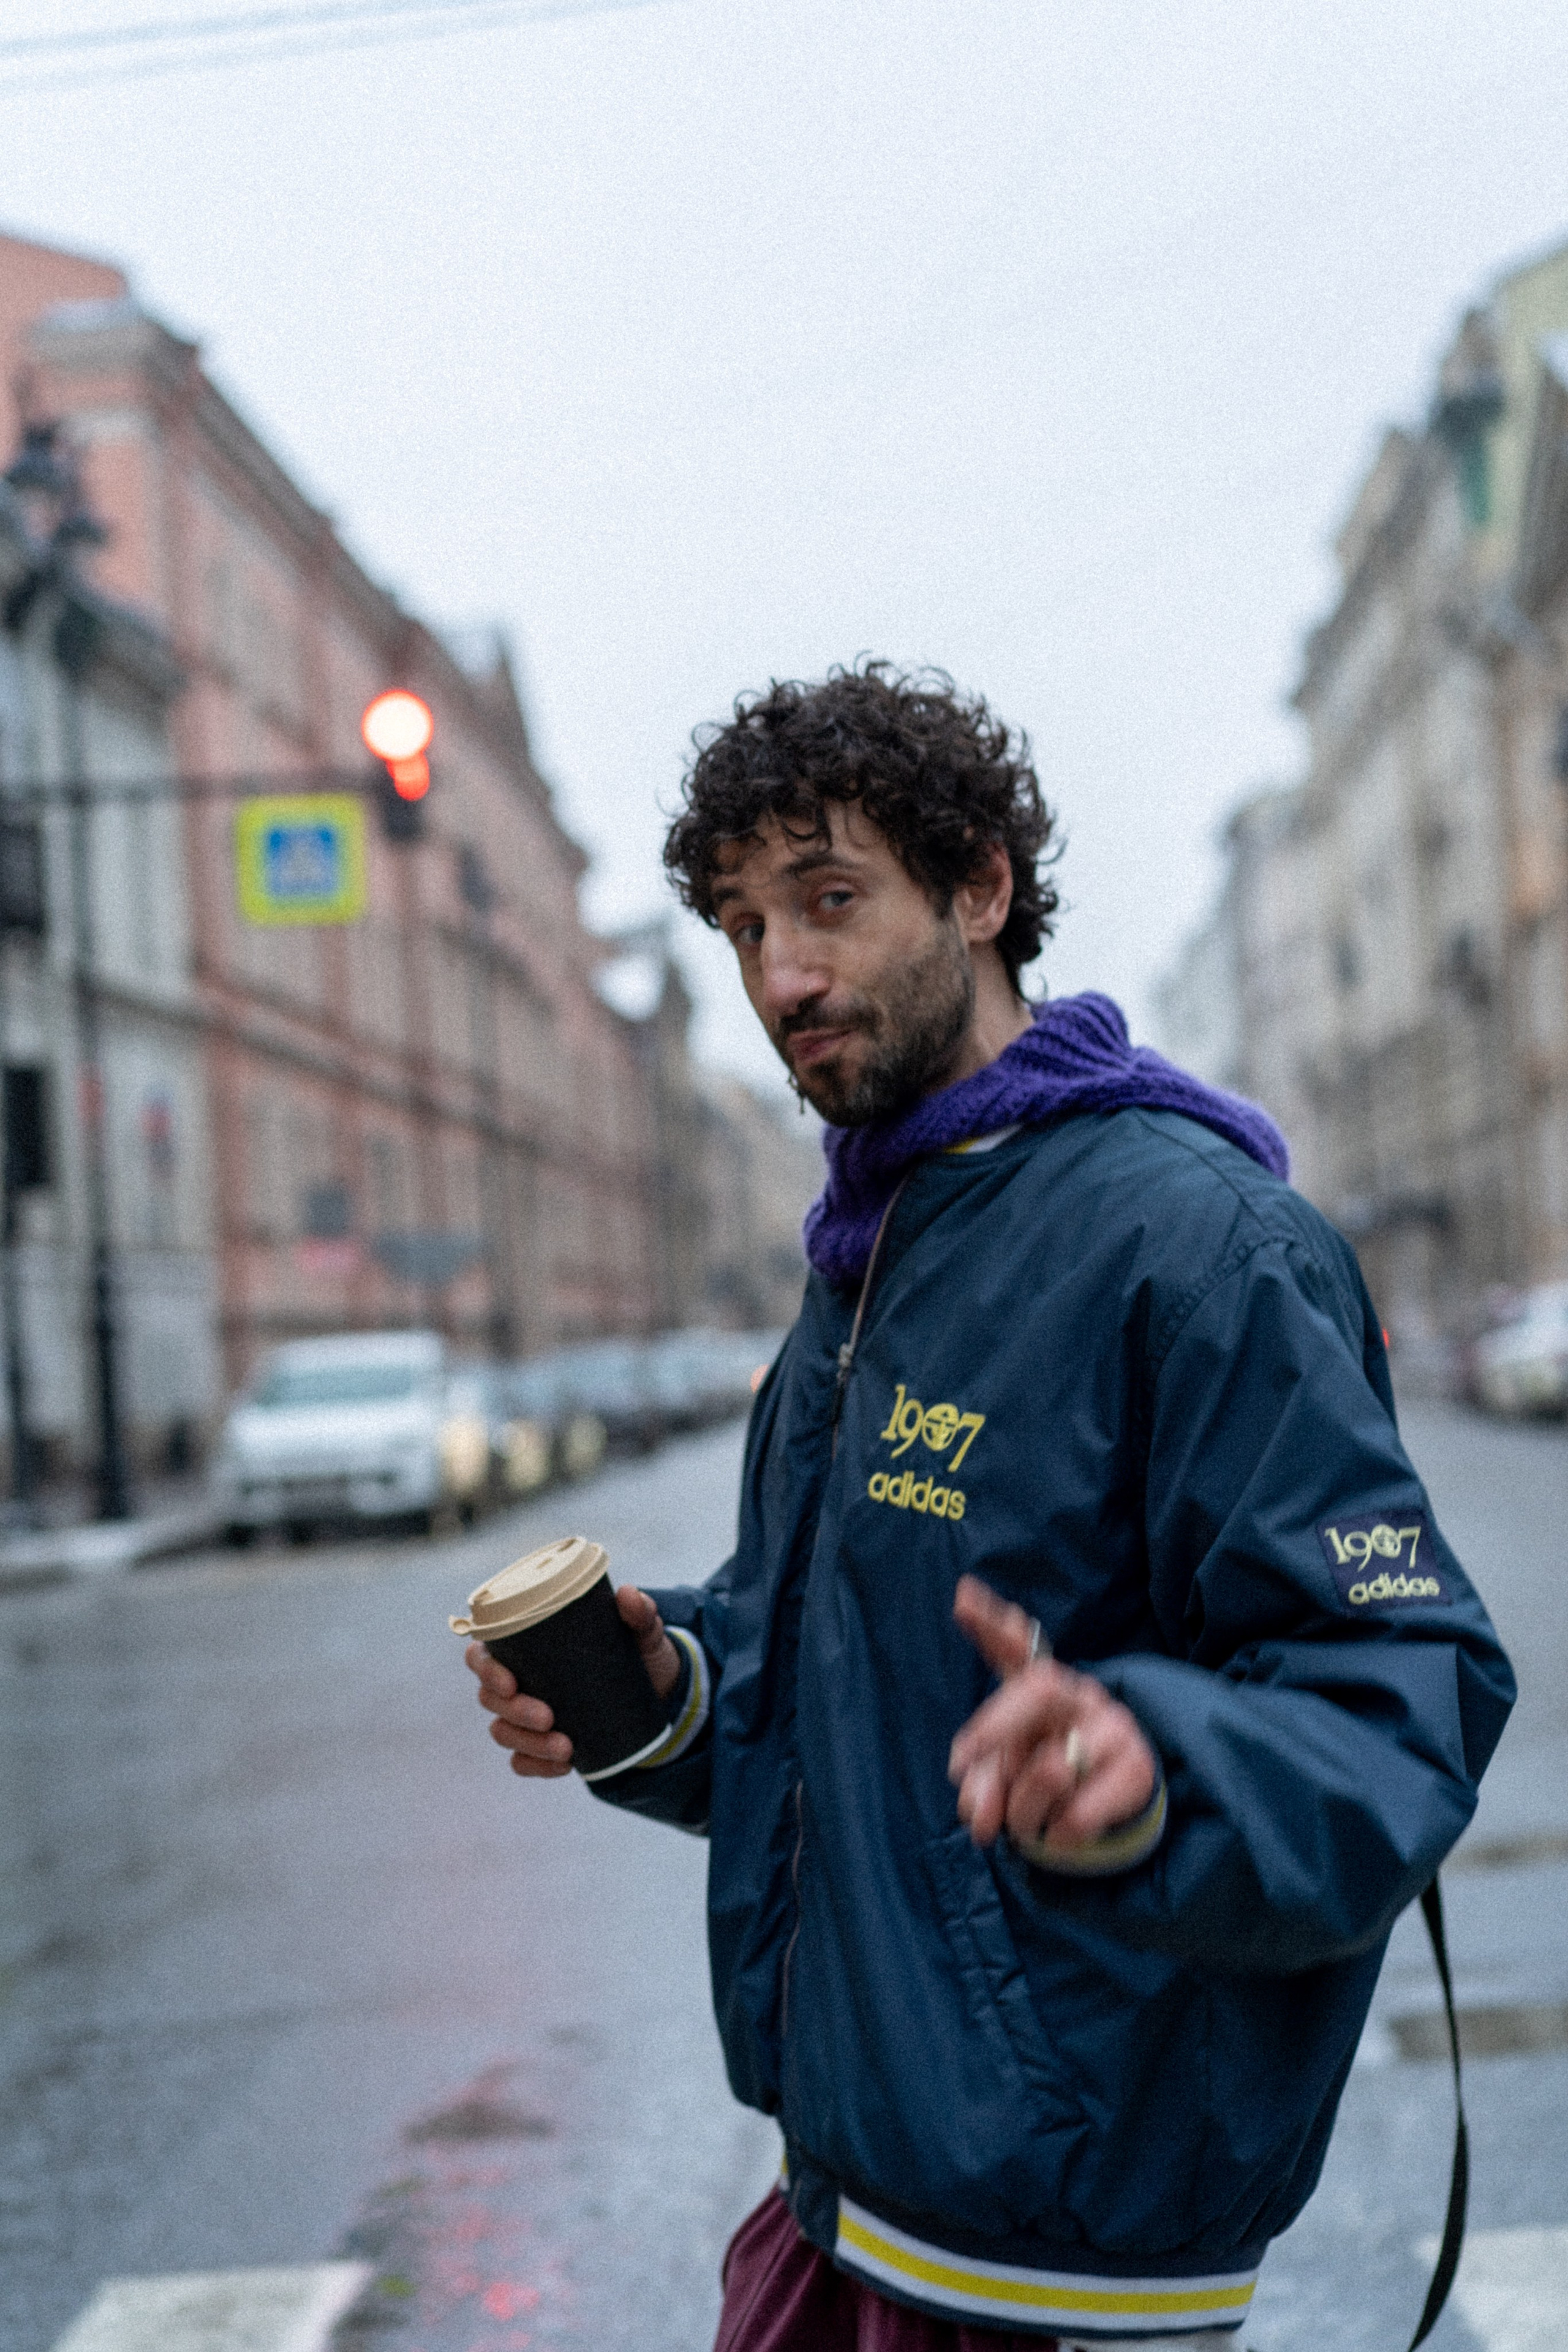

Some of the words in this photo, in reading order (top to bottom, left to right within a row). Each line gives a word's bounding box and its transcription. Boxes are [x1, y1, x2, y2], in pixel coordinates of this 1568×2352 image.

[880, 1384, 986, 1472] 1907
[867, 1470, 967, 1520] adidas
[1324, 1523, 1422, 1572] 1907
[1348, 1572, 1440, 1605] adidas
